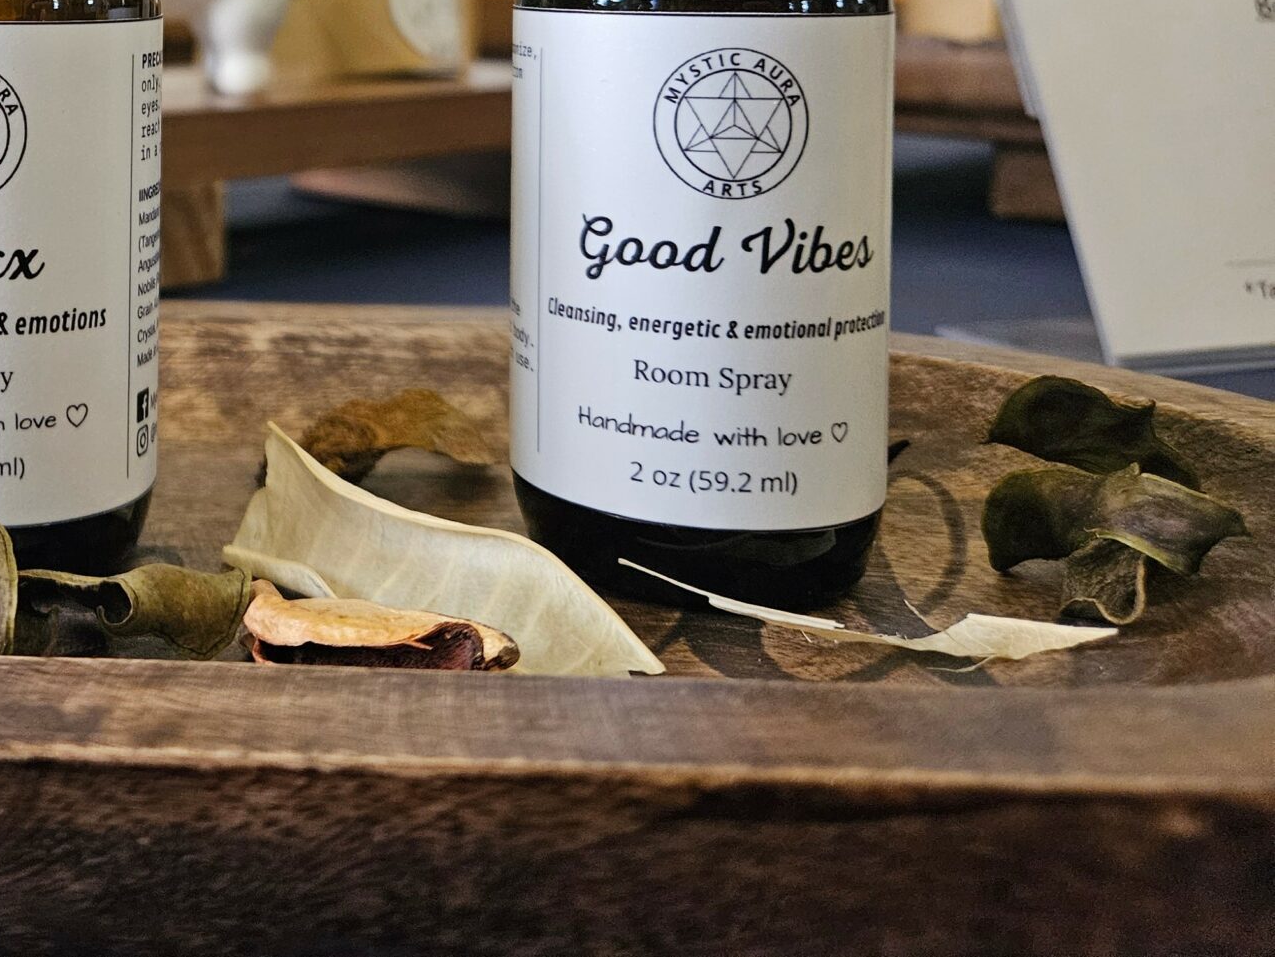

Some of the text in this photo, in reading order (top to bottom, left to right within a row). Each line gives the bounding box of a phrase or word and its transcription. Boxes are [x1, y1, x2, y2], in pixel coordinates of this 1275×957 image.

[664, 53, 800, 107] MYSTIC AURA
[140, 144, 150, 161] in
[703, 180, 763, 197] ARTS
[579, 213, 874, 279] Good Vibes
[16, 307, 107, 335] emotions
[548, 297, 622, 332] Cleansing,
[629, 318, 720, 341] energetic
[727, 321, 739, 339] &
[745, 316, 831, 340] emotional
[834, 309, 886, 341] protection
[633, 360, 792, 396] Room Spray
[15, 412, 57, 430] love
[578, 405, 821, 447] Handmade with love
[630, 462, 798, 495] 2 oz (59.2 ml)
